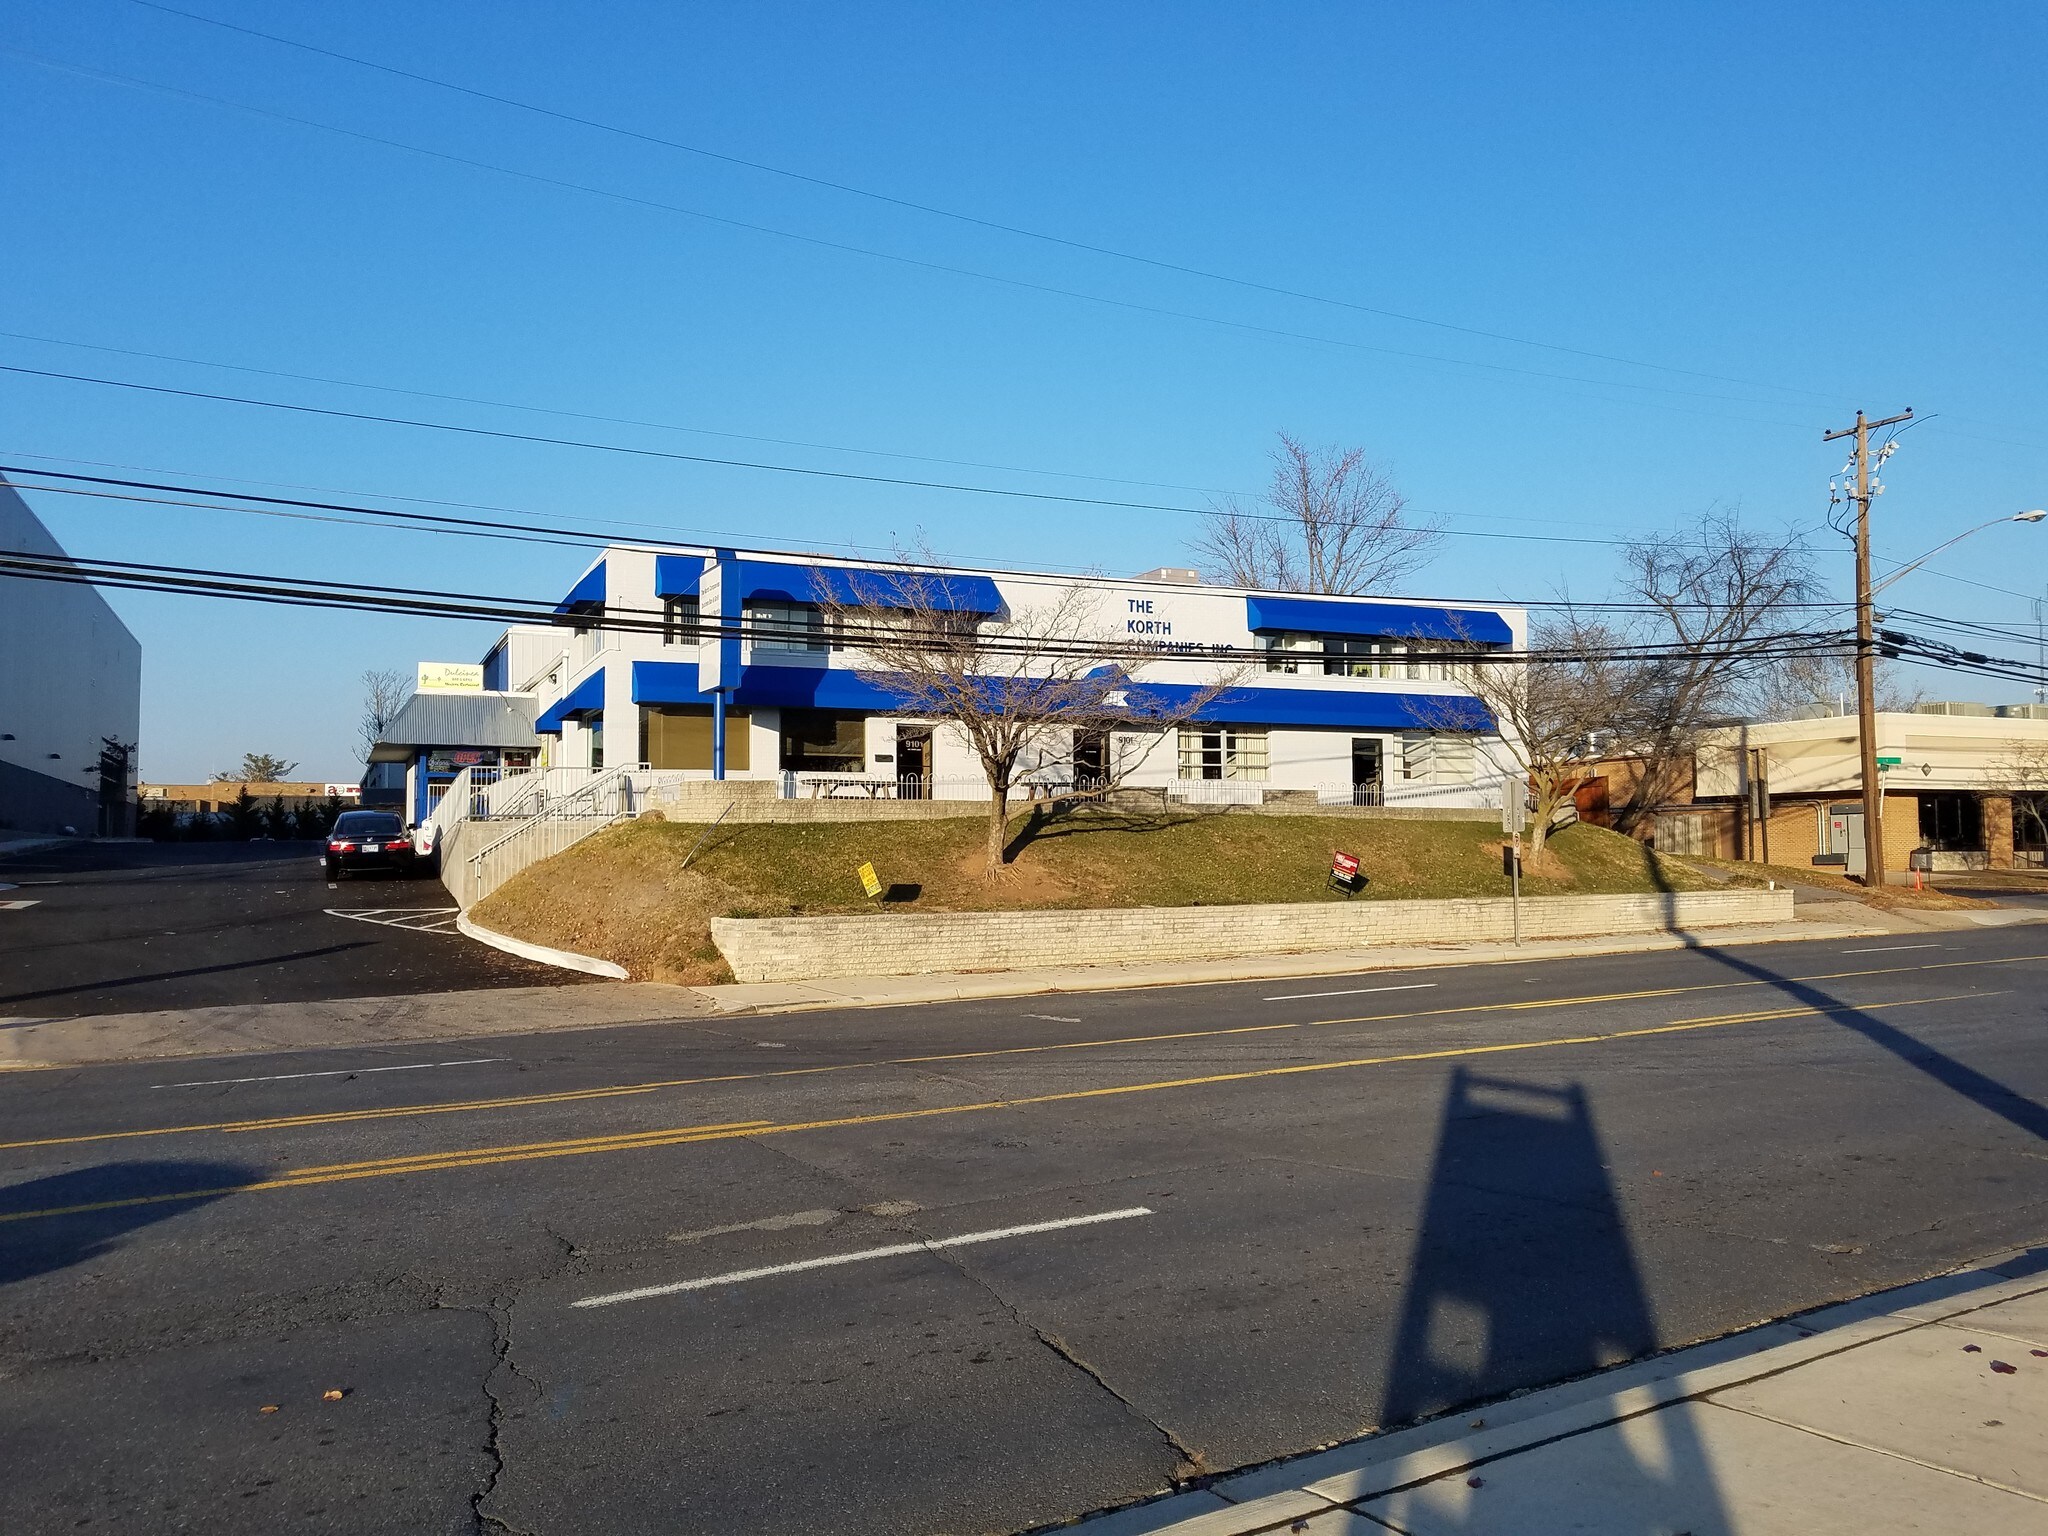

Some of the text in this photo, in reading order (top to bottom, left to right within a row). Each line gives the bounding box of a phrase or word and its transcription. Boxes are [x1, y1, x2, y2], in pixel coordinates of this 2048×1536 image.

[1128, 599, 1153, 613] THE
[1127, 620, 1171, 635] KORTH
[905, 740, 923, 748] 9101
